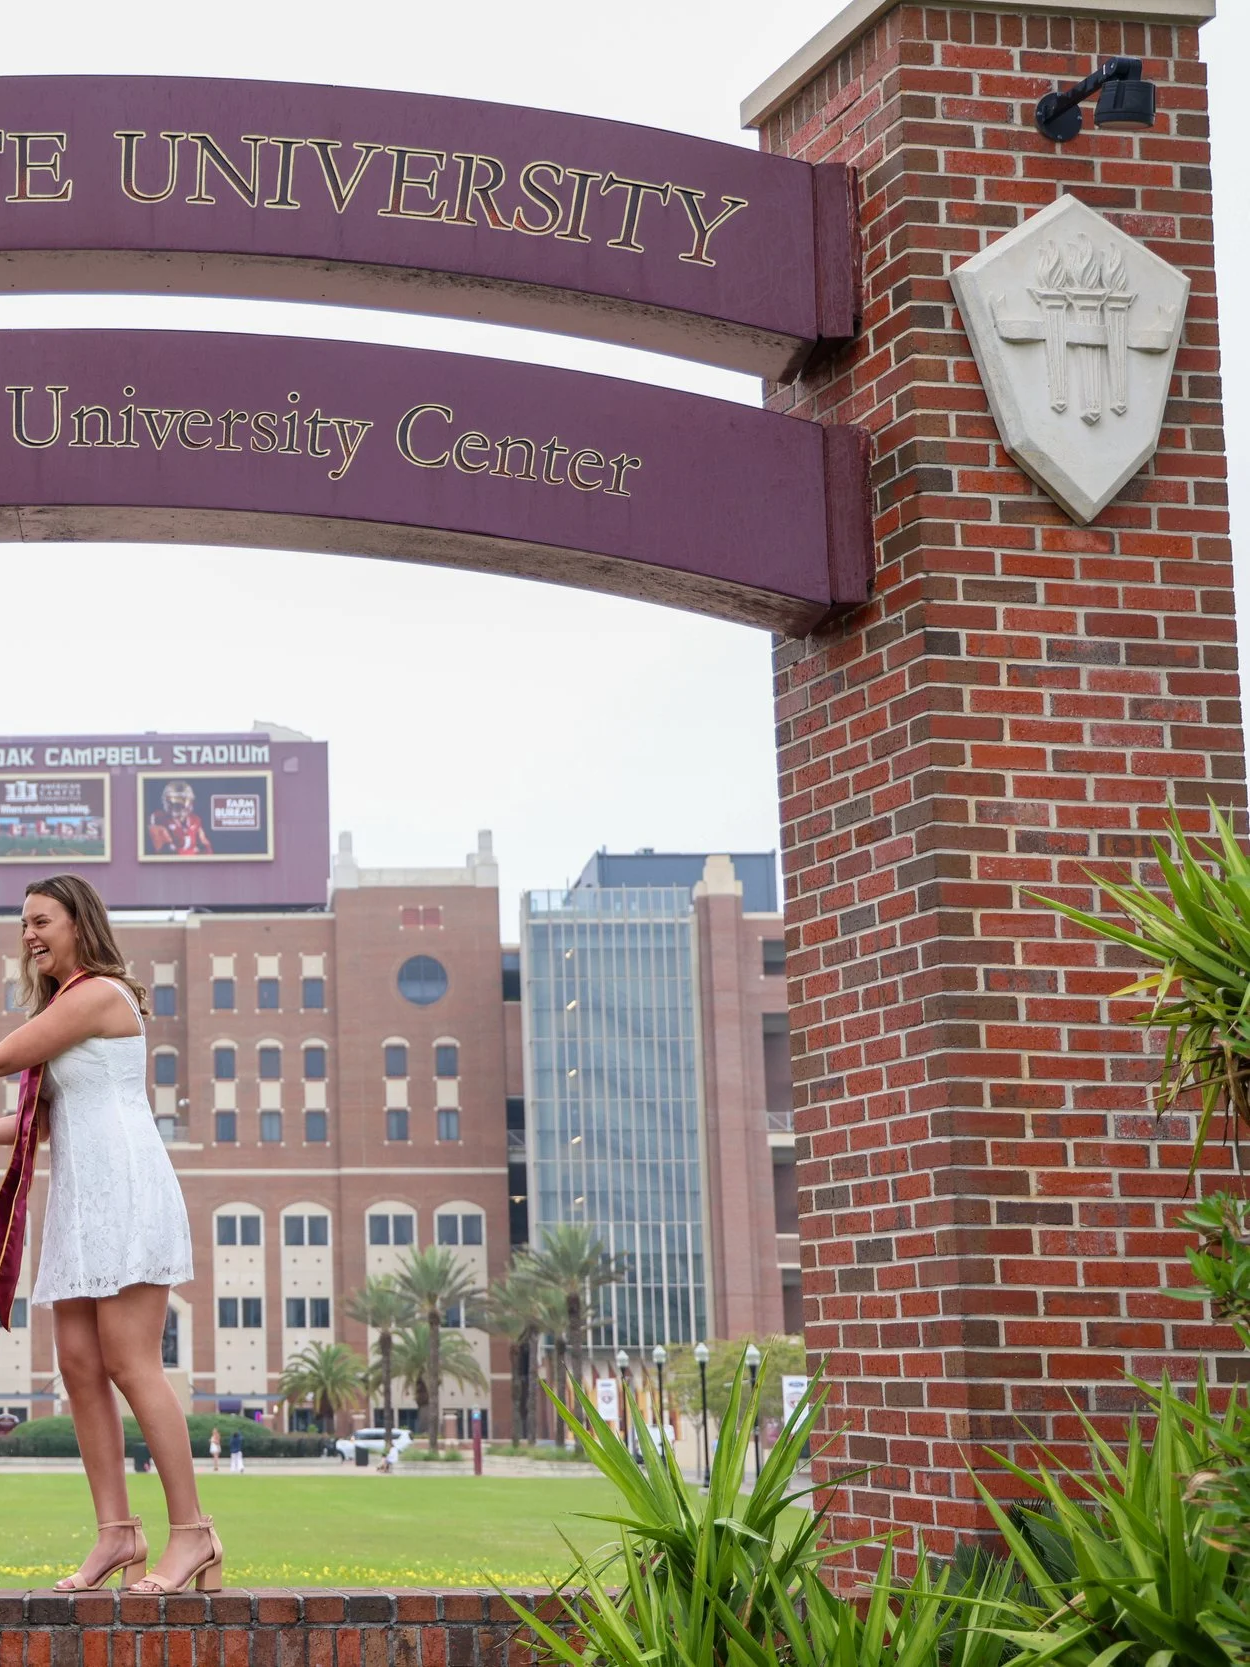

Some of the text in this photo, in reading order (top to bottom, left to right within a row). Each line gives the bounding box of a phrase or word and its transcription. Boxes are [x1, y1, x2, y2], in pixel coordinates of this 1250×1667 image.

[114, 130, 748, 266] UNIVERSITY
[5, 385, 373, 480] University
[396, 404, 642, 497] Center
[45, 746, 162, 767] CAMPBELL
[173, 745, 269, 764] STADIUM
[215, 807, 255, 818] BUREAU
[226, 799, 254, 808] FARM
